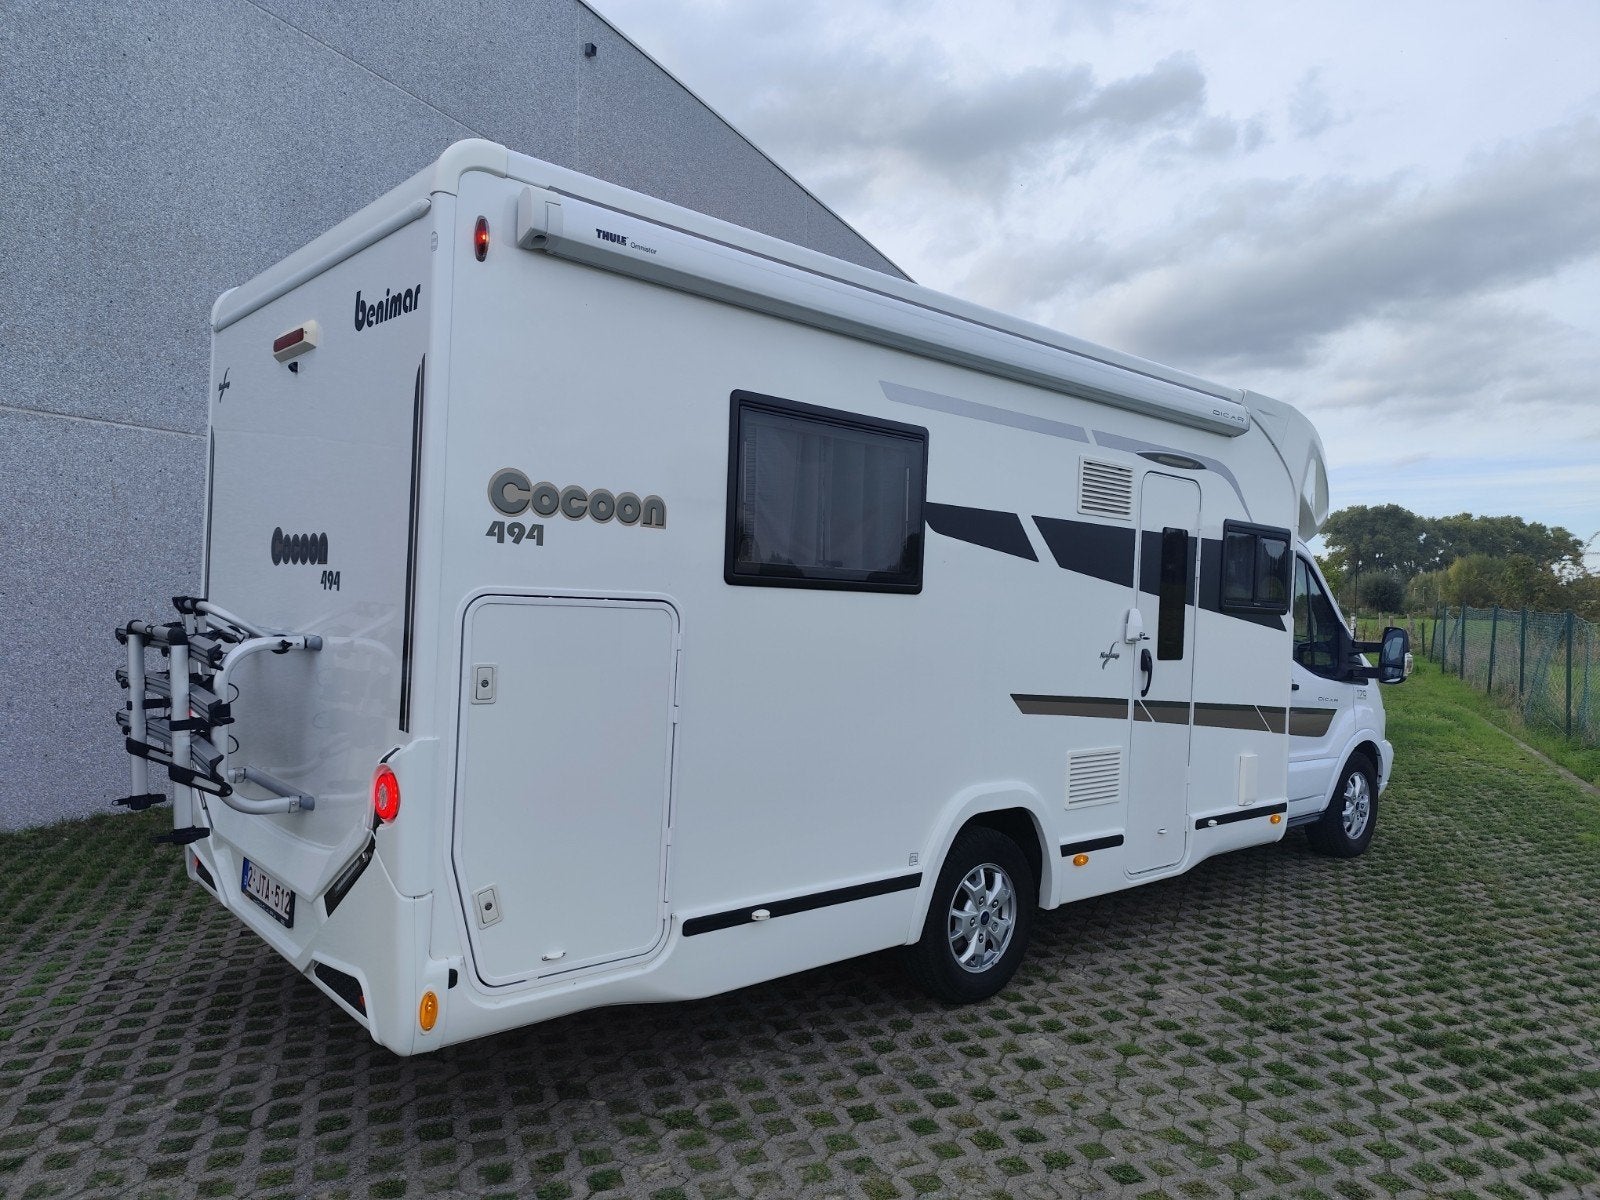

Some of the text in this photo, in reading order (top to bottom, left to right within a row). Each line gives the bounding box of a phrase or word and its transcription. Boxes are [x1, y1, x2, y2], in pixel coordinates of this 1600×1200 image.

[596, 228, 627, 246] THULE
[354, 284, 421, 332] benimar
[1212, 409, 1245, 423] DICAR
[487, 467, 667, 529] Cocoon
[271, 526, 328, 566] Cocoon
[485, 520, 544, 546] 494
[320, 570, 341, 591] 494
